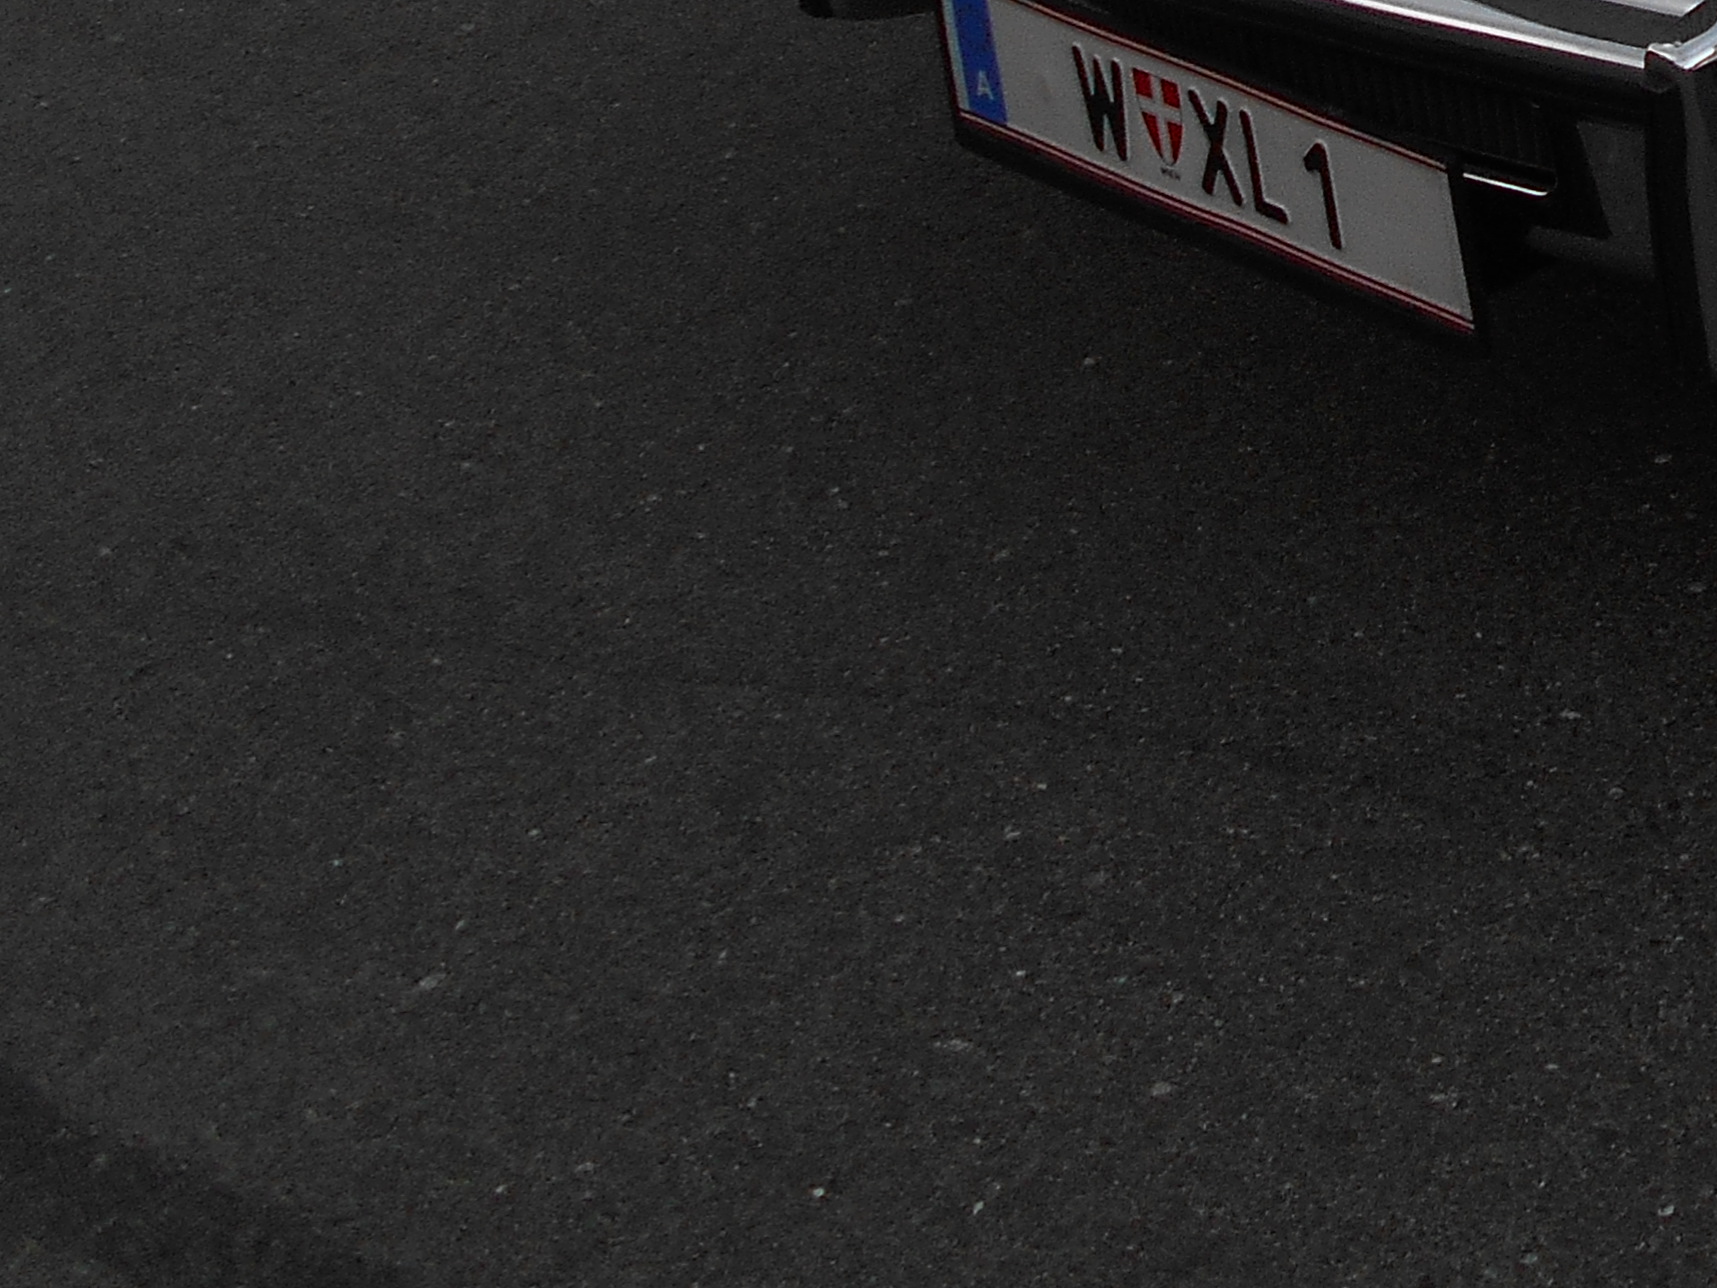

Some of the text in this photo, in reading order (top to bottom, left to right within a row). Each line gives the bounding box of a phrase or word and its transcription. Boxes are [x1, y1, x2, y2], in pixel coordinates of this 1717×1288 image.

[976, 69, 995, 101] A
[1071, 41, 1344, 252] W XL 1
